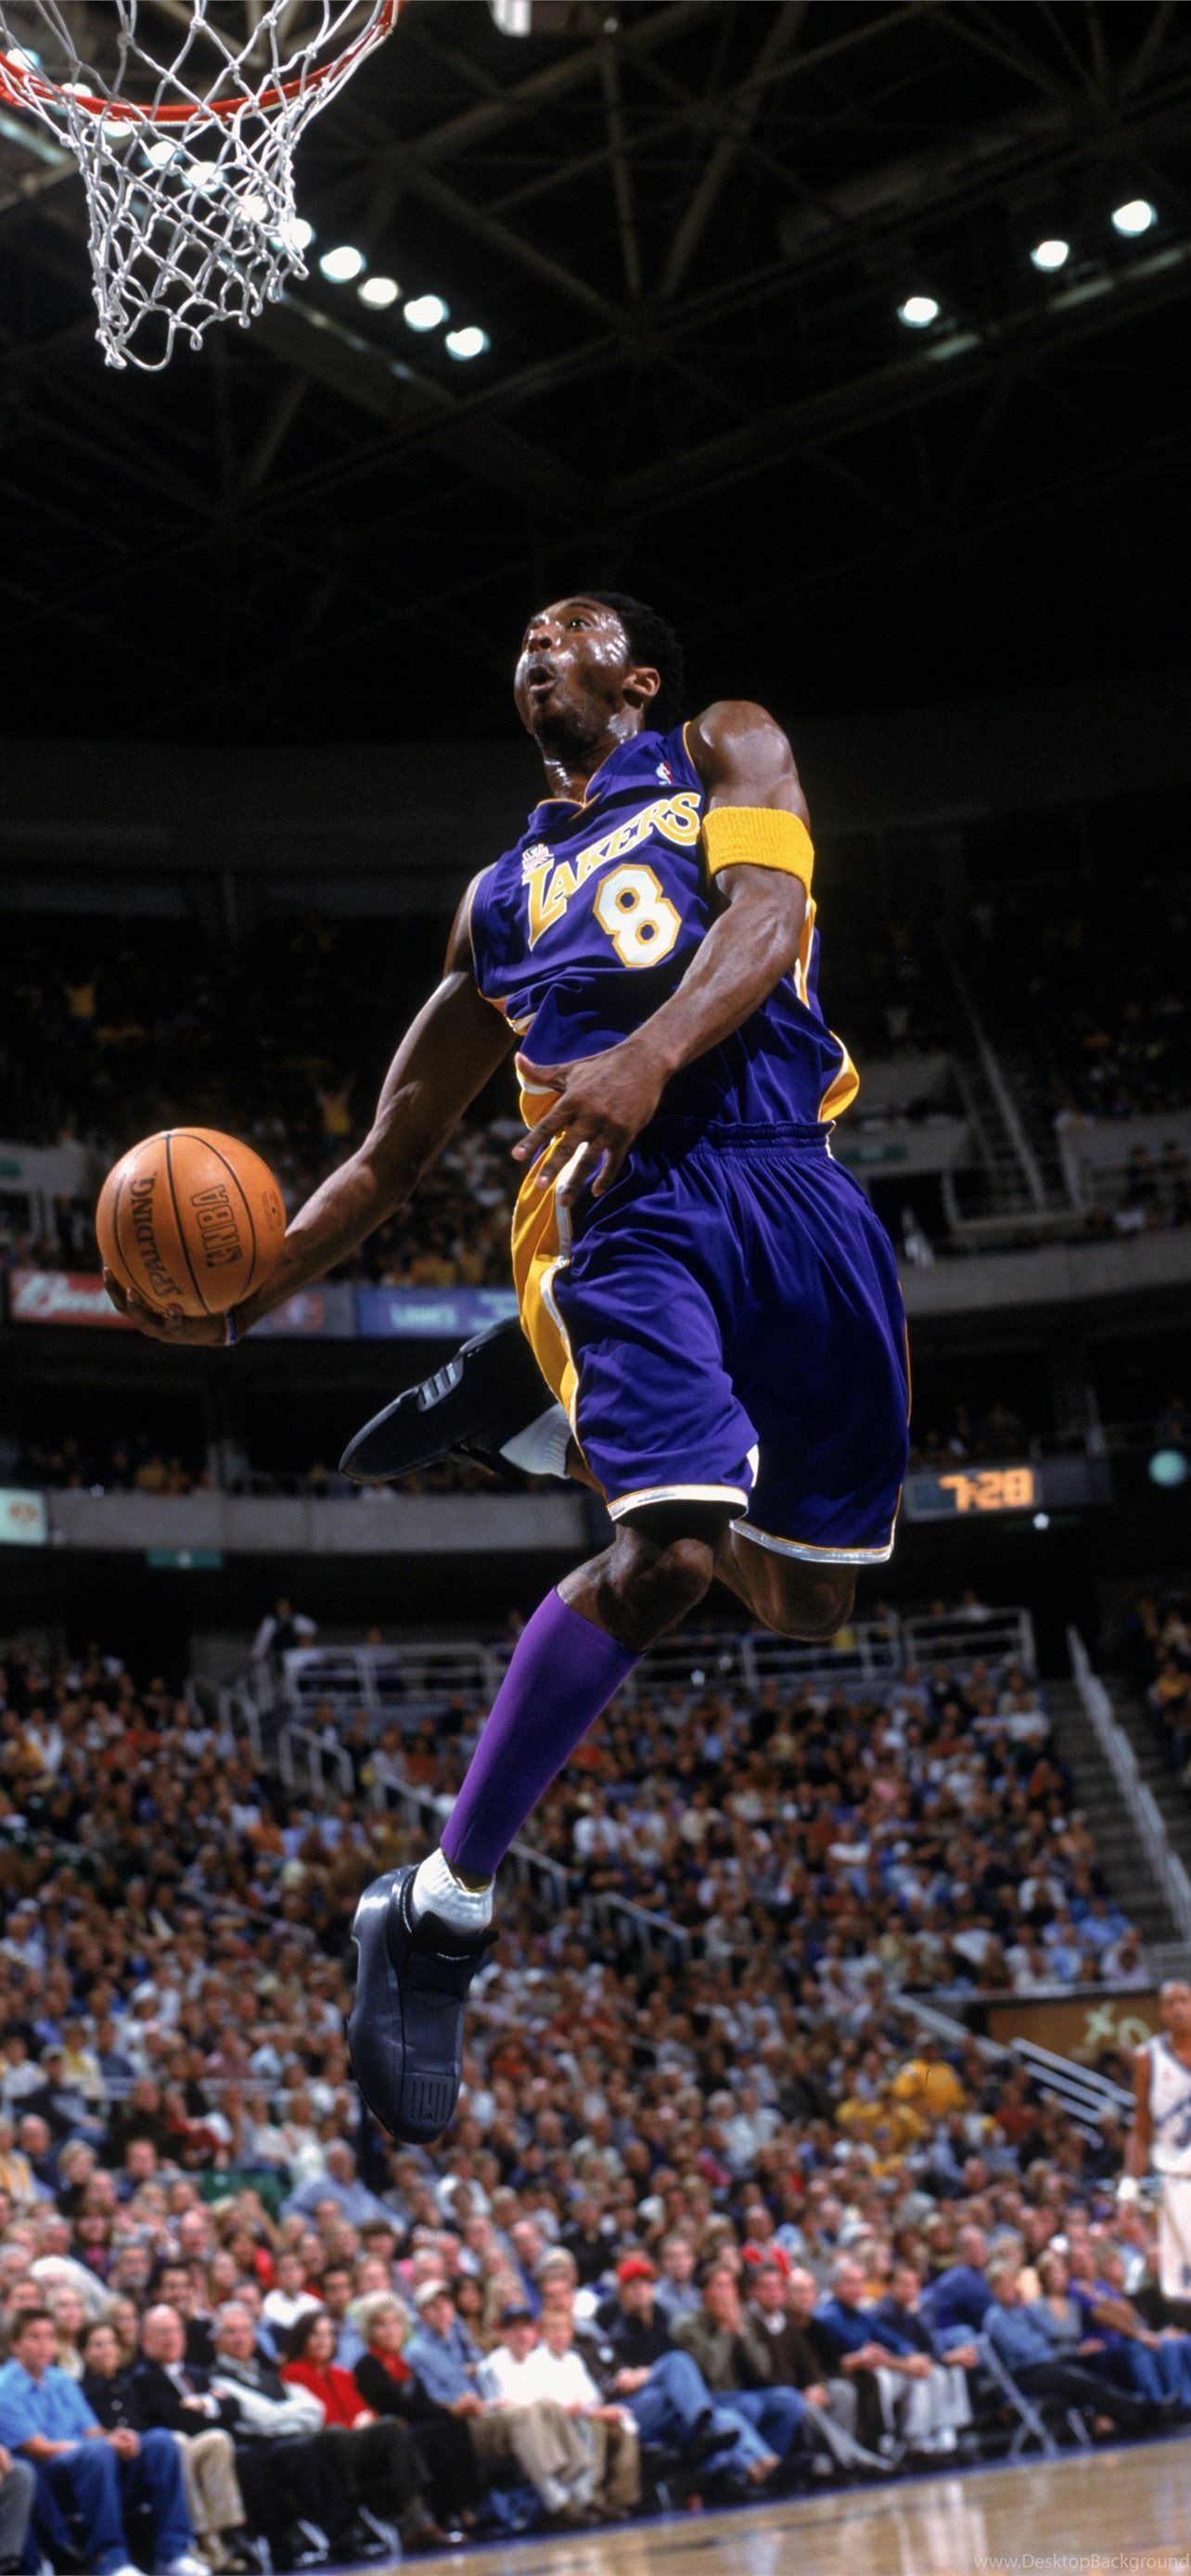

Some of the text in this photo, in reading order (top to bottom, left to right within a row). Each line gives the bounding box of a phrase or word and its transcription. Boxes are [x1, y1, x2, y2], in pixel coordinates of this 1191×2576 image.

[521, 792, 702, 952] LAKERS
[593, 863, 683, 968] 8
[130, 1177, 185, 1297] SPALDING
[190, 1184, 239, 1251] NBA
